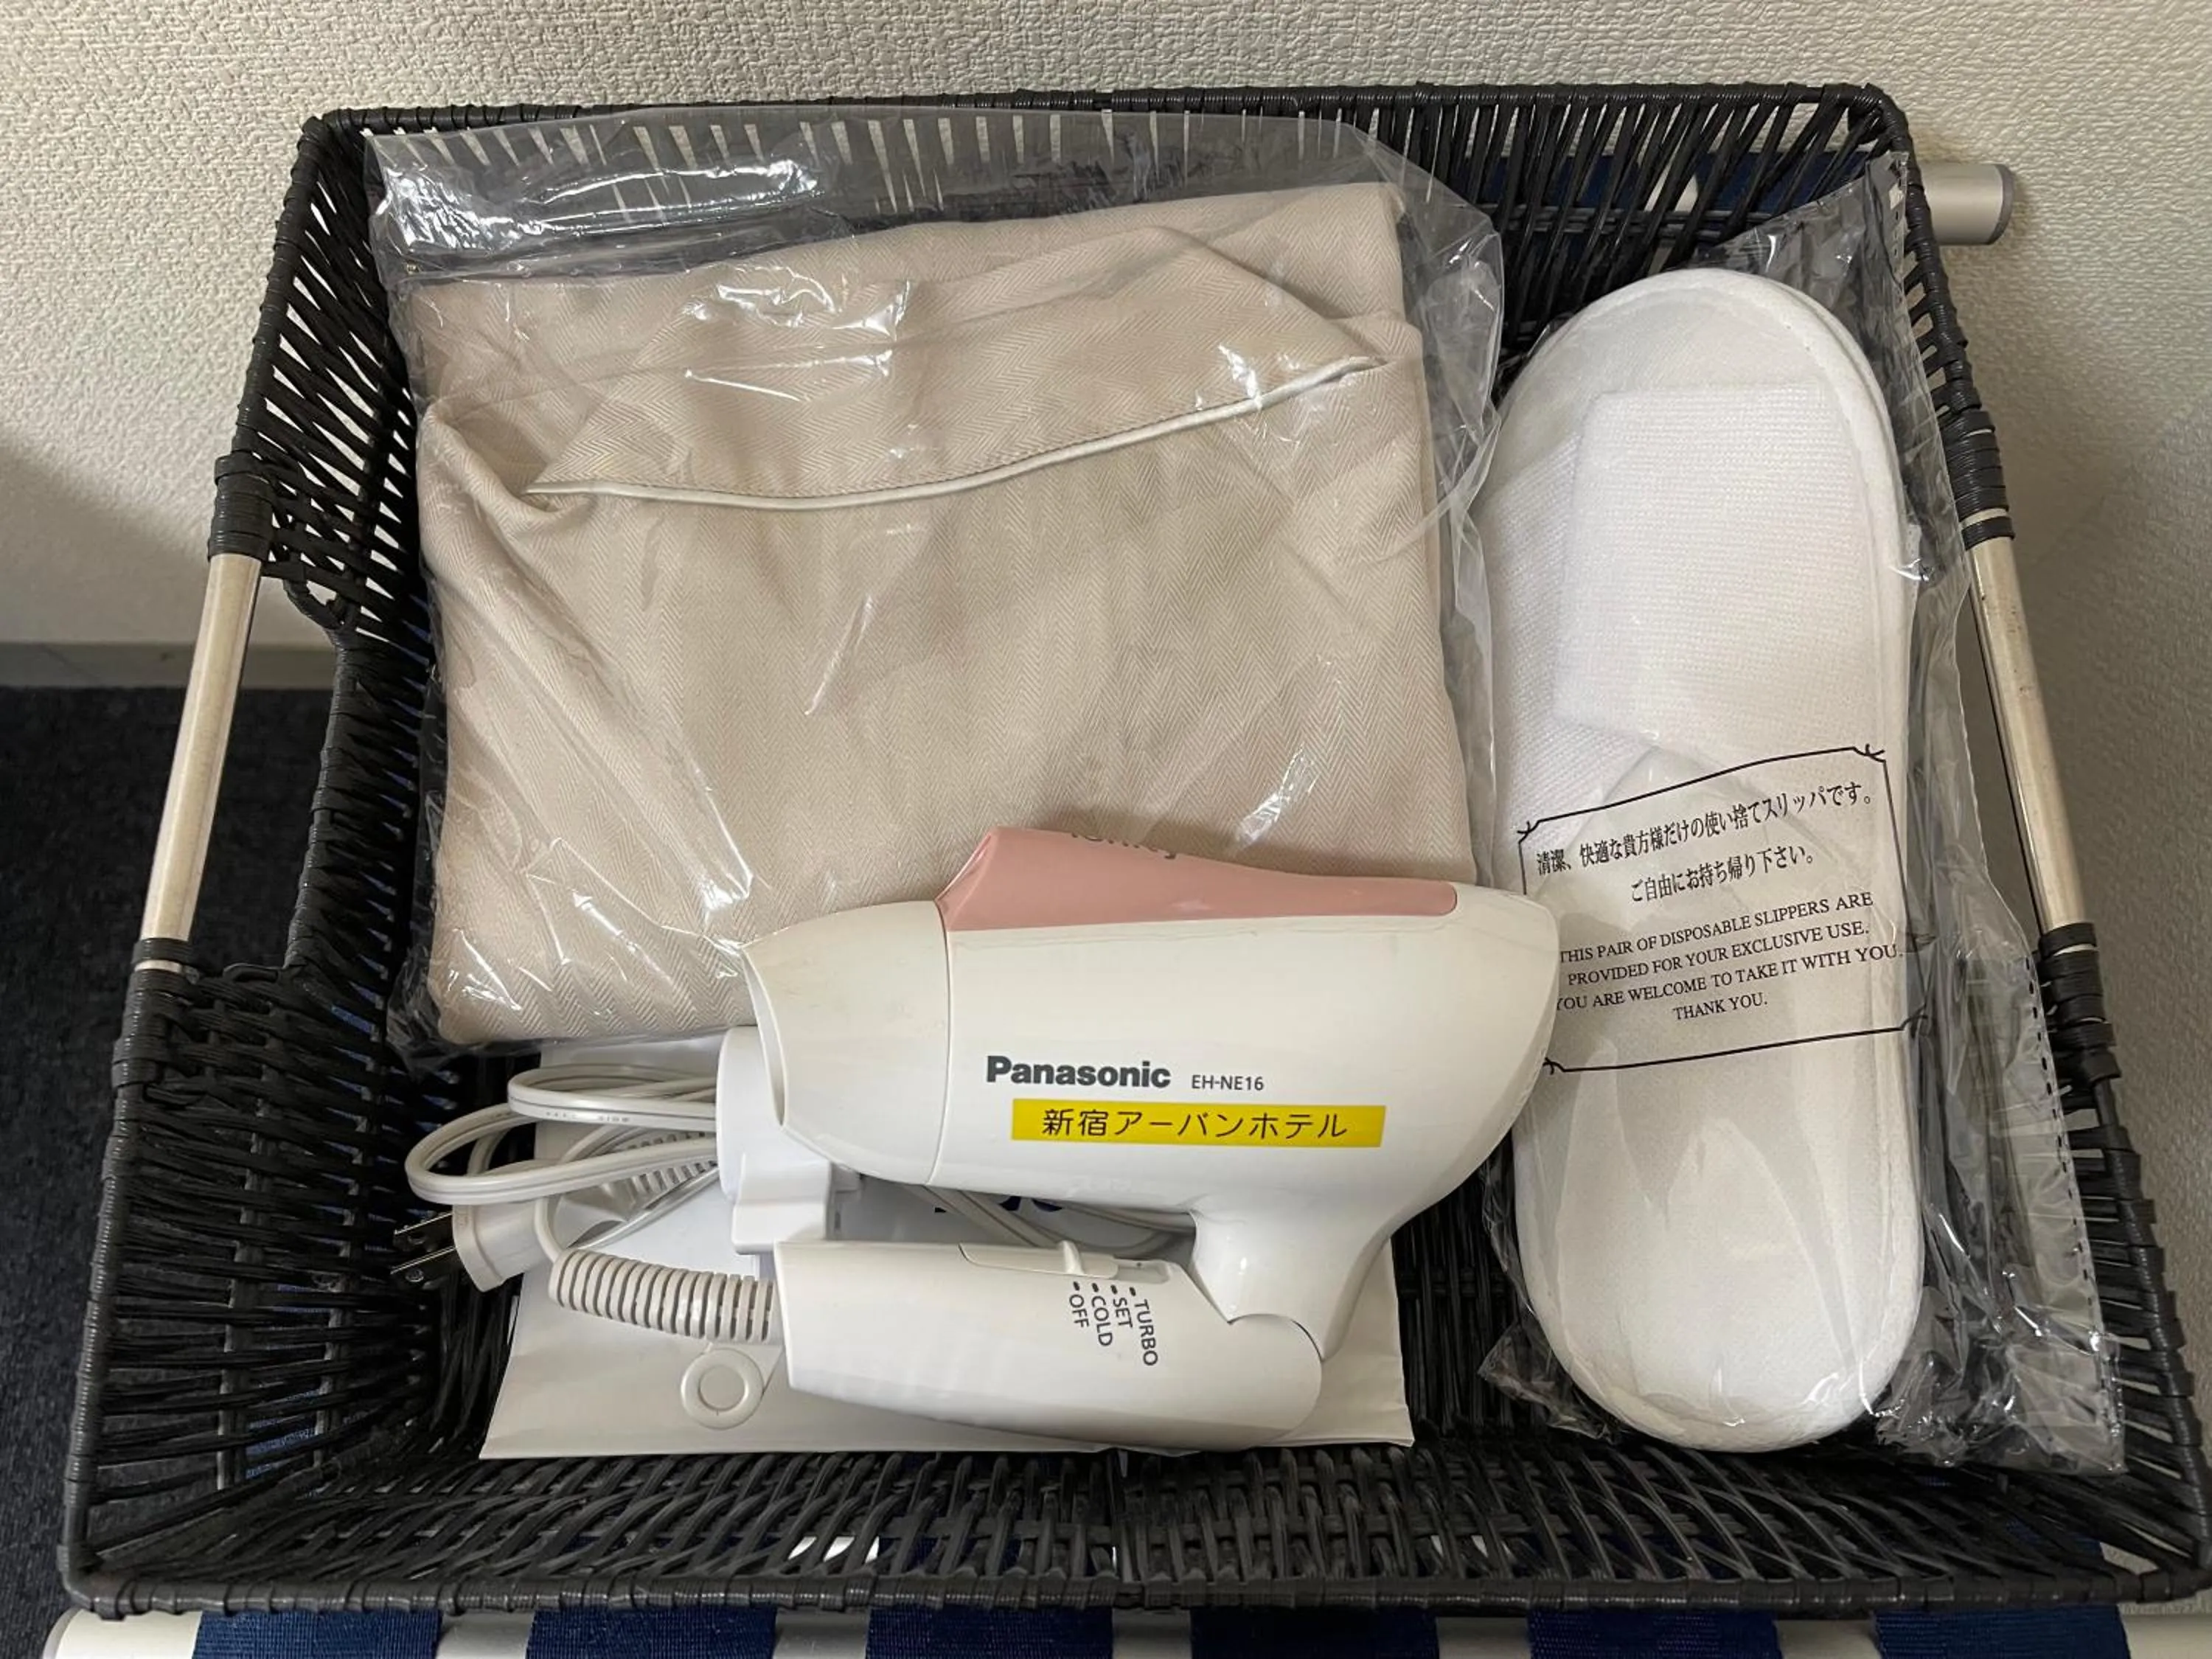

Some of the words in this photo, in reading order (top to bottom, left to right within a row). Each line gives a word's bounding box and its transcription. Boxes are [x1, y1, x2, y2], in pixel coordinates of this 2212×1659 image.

[1537, 781, 1871, 876] 清潔、快適な貴方様だけの使い捨てスリッパです。
[1631, 846, 1813, 902] ご自由にお持ち帰り下さい。
[1560, 947, 1594, 964] THIS
[1597, 940, 1633, 958] PAIR
[1636, 936, 1658, 952] OF
[1660, 915, 1752, 947] DISPOSABLE
[1754, 899, 1829, 927] SLIPPERS
[1836, 891, 1874, 911] ARE
[1568, 962, 1649, 986] PROVIDED
[1652, 956, 1683, 974] FOR
[1686, 947, 1729, 967] YOUR
[1731, 927, 1823, 959] EXCLUSIVE
[1826, 920, 1870, 939] USE.
[1592, 991, 1625, 1008] ARE
[1627, 977, 1708, 1001] WELCOME
[1711, 971, 1732, 987] TO
[1735, 964, 1779, 983] TAKE
[1781, 959, 1798, 975] IT
[1801, 949, 1851, 970] WITH
[1854, 944, 1904, 962] YOU.
[1672, 998, 1726, 1020] THANK
[1728, 992, 1768, 1010] YOU.
[986, 1054, 1172, 1089] Panasonic
[1191, 1074, 1265, 1091] EH-NE16
[1041, 1107, 1348, 1140] 新宿アーバンホテル
[1069, 1293, 1090, 1328] OFF
[1091, 1295, 1113, 1347] COLD
[1112, 1296, 1133, 1329] SET
[1134, 1298, 1158, 1366] TURBO
